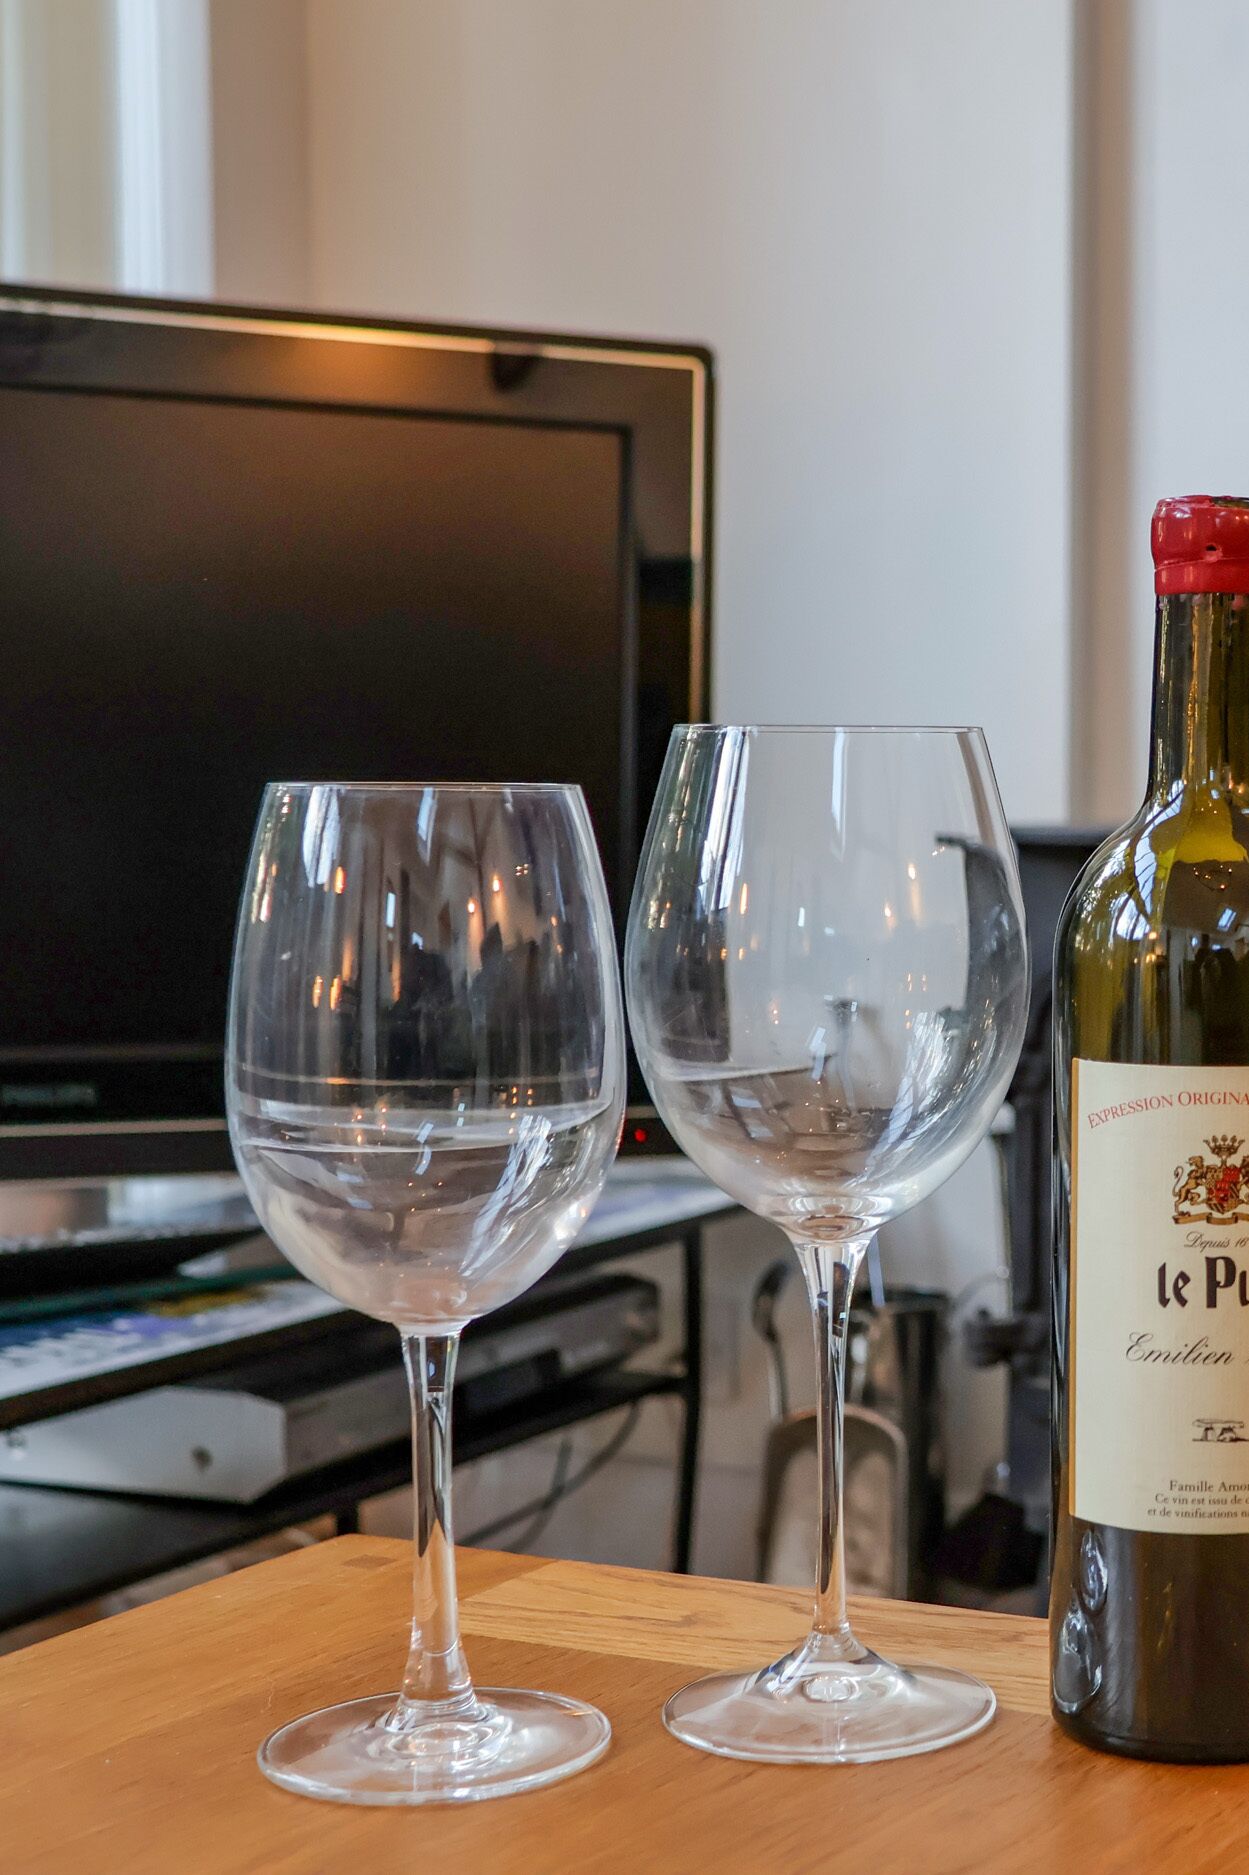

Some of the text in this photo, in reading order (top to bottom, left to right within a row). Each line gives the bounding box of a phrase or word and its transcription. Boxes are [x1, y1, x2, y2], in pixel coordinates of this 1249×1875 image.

[1087, 1094, 1174, 1129] EXPRESSION
[1183, 1230, 1231, 1253] Depuis
[1157, 1262, 1192, 1309] le
[1125, 1331, 1236, 1367] Emilien
[1169, 1479, 1215, 1493] Famille
[1154, 1492, 1169, 1505] Ce
[1172, 1495, 1188, 1505] vin
[1190, 1496, 1206, 1506] est
[1208, 1496, 1228, 1506] issu
[1230, 1494, 1243, 1505] de
[1147, 1506, 1157, 1517] et
[1159, 1506, 1172, 1518] de
[1174, 1507, 1238, 1519] vinifications
